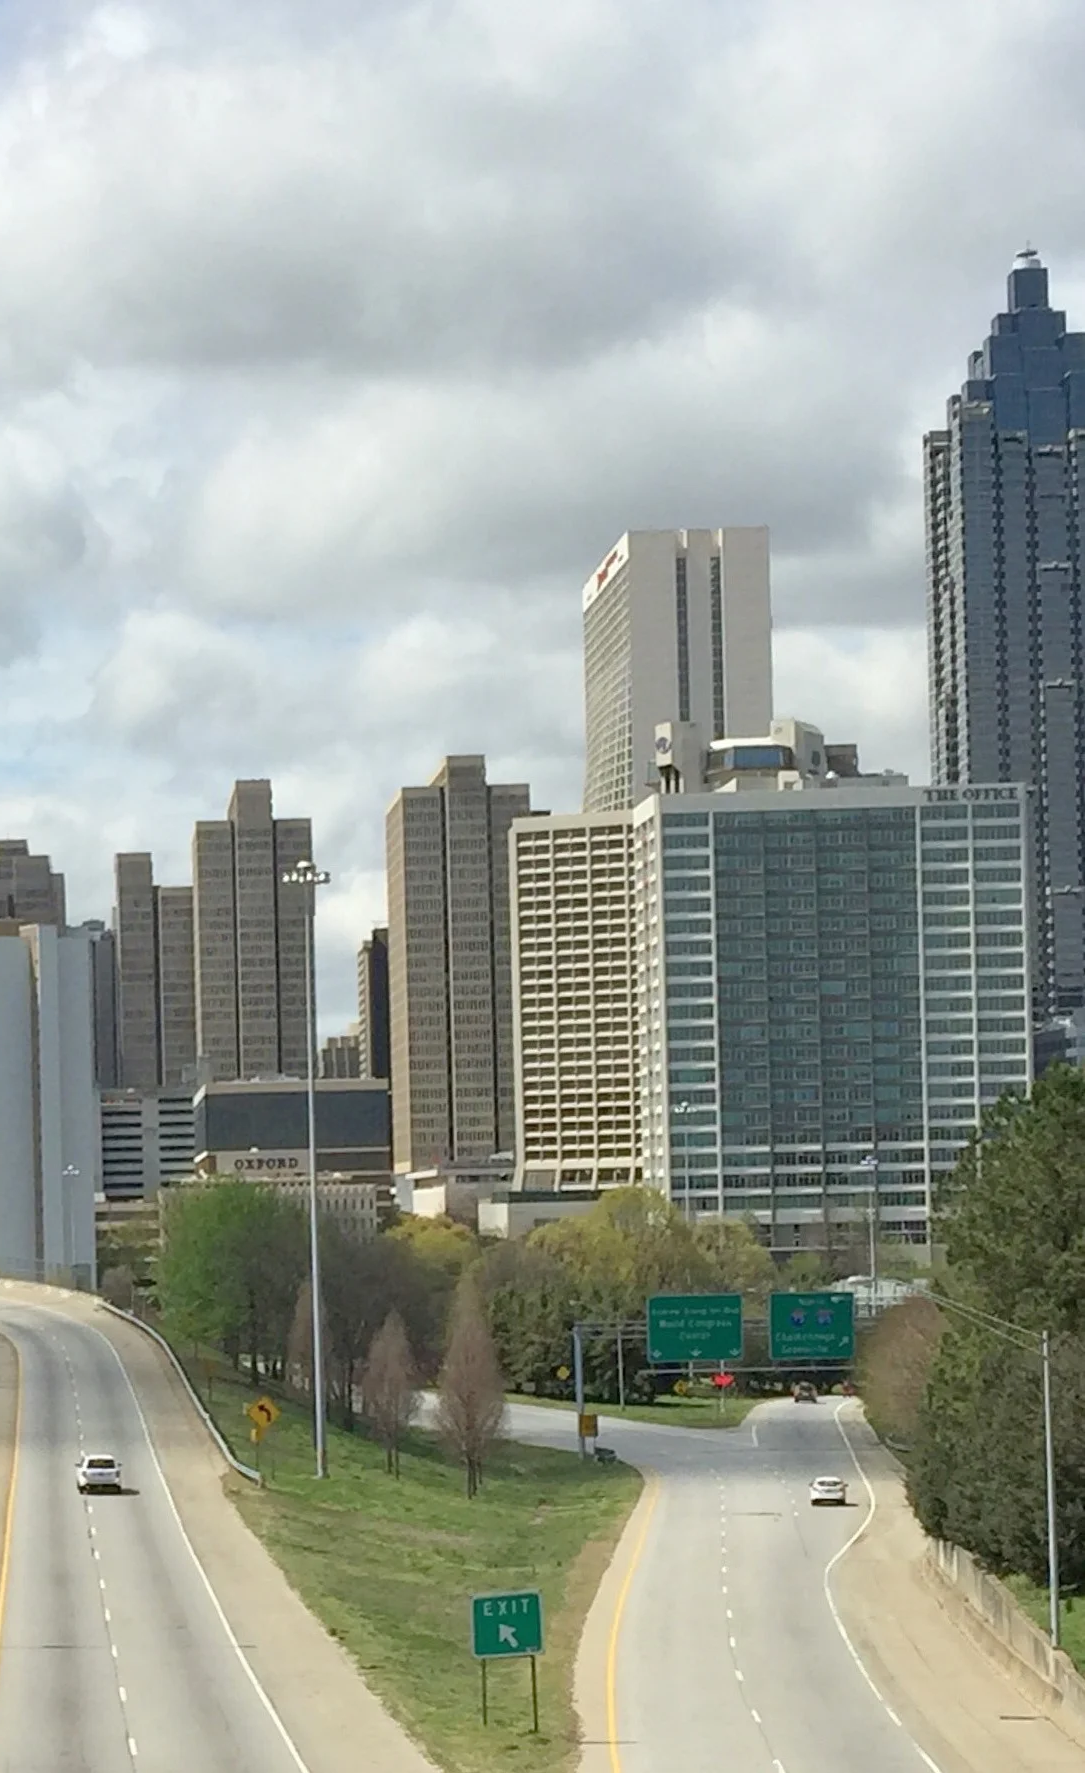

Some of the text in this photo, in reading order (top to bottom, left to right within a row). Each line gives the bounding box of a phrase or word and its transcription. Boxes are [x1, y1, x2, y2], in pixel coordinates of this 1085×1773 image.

[924, 787, 1018, 802] THE OFFICE
[233, 1157, 299, 1171] OXFORD
[483, 1598, 530, 1617] EXIT
